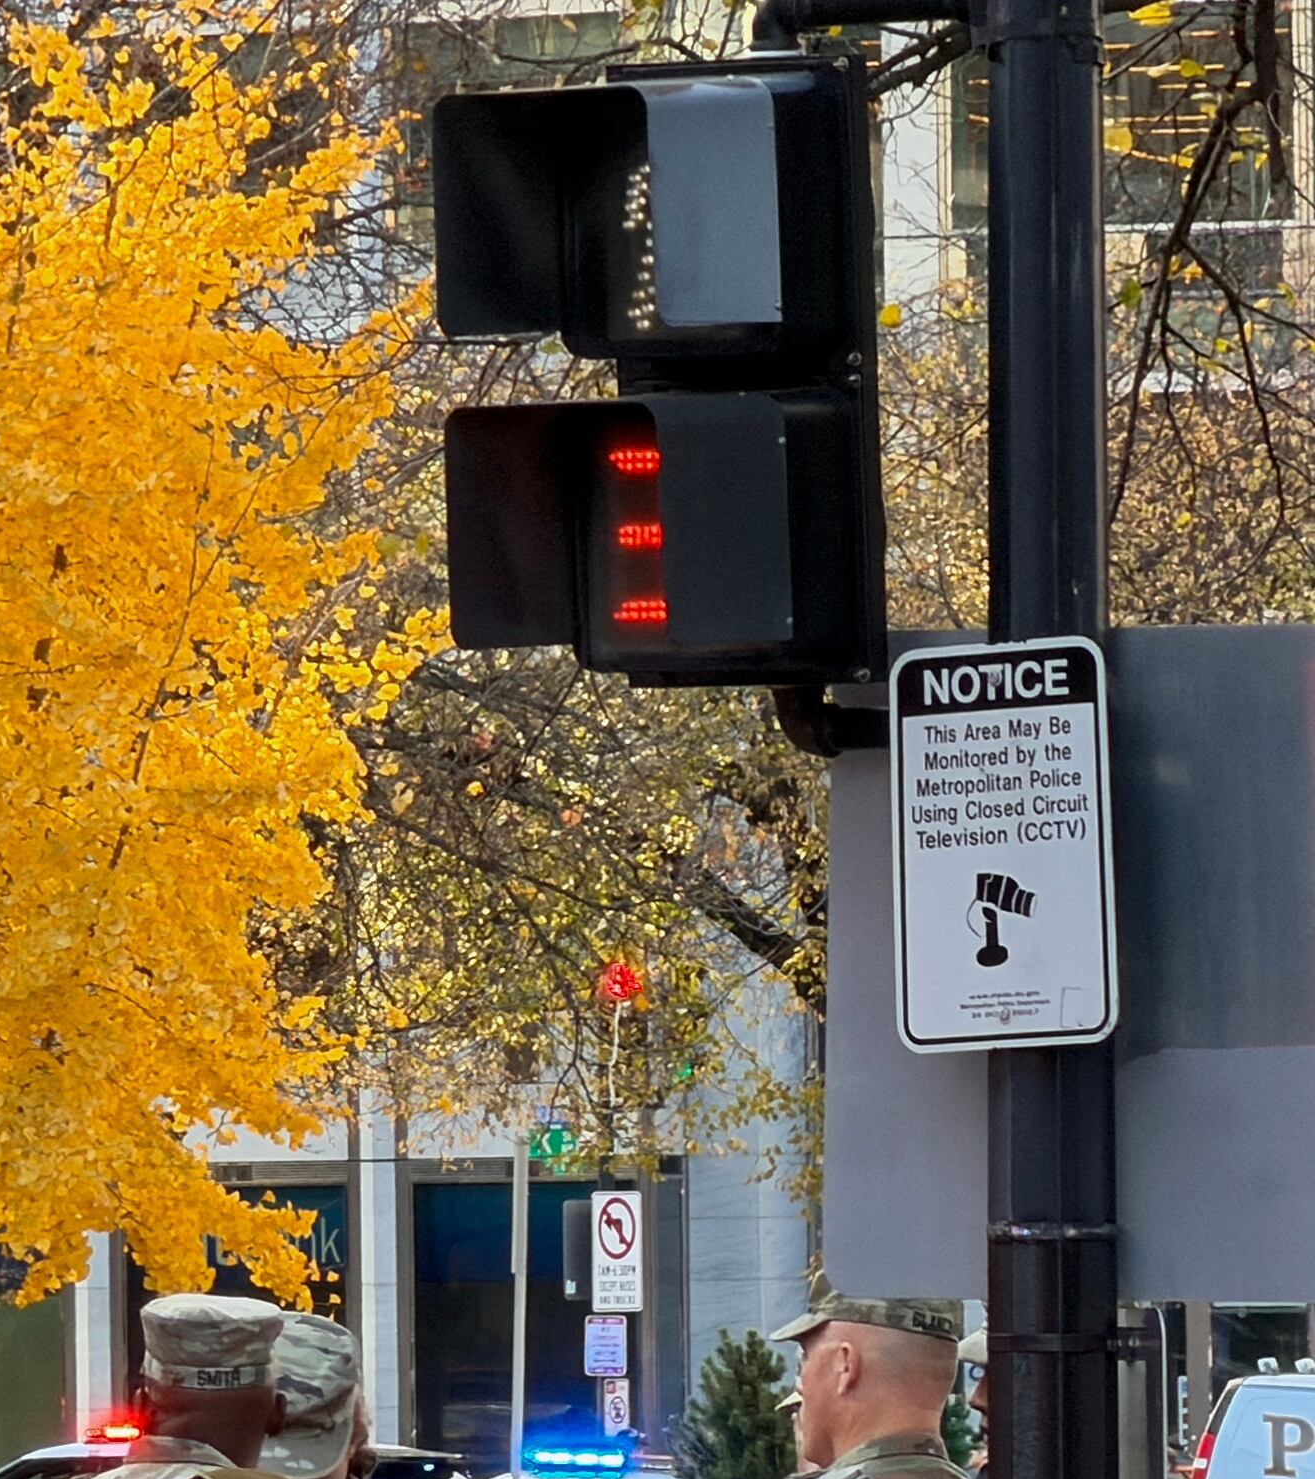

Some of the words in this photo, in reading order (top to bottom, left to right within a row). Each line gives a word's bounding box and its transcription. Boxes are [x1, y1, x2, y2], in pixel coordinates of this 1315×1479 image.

[924, 659, 1069, 705] NOTICE
[924, 724, 956, 745] This
[964, 721, 1000, 741] Area
[1009, 719, 1041, 740] May
[1050, 717, 1071, 735] Be
[924, 746, 1008, 771] Monitored
[1016, 747, 1036, 766] by
[1045, 744, 1071, 761] the
[917, 771, 1022, 797] Metropolitan
[1030, 769, 1081, 788] Police
[911, 804, 958, 826] Using
[965, 798, 1025, 820] Closed
[1033, 794, 1089, 816] Circuit
[917, 825, 1008, 850] Television
[1017, 818, 1087, 845] (CCTV)
